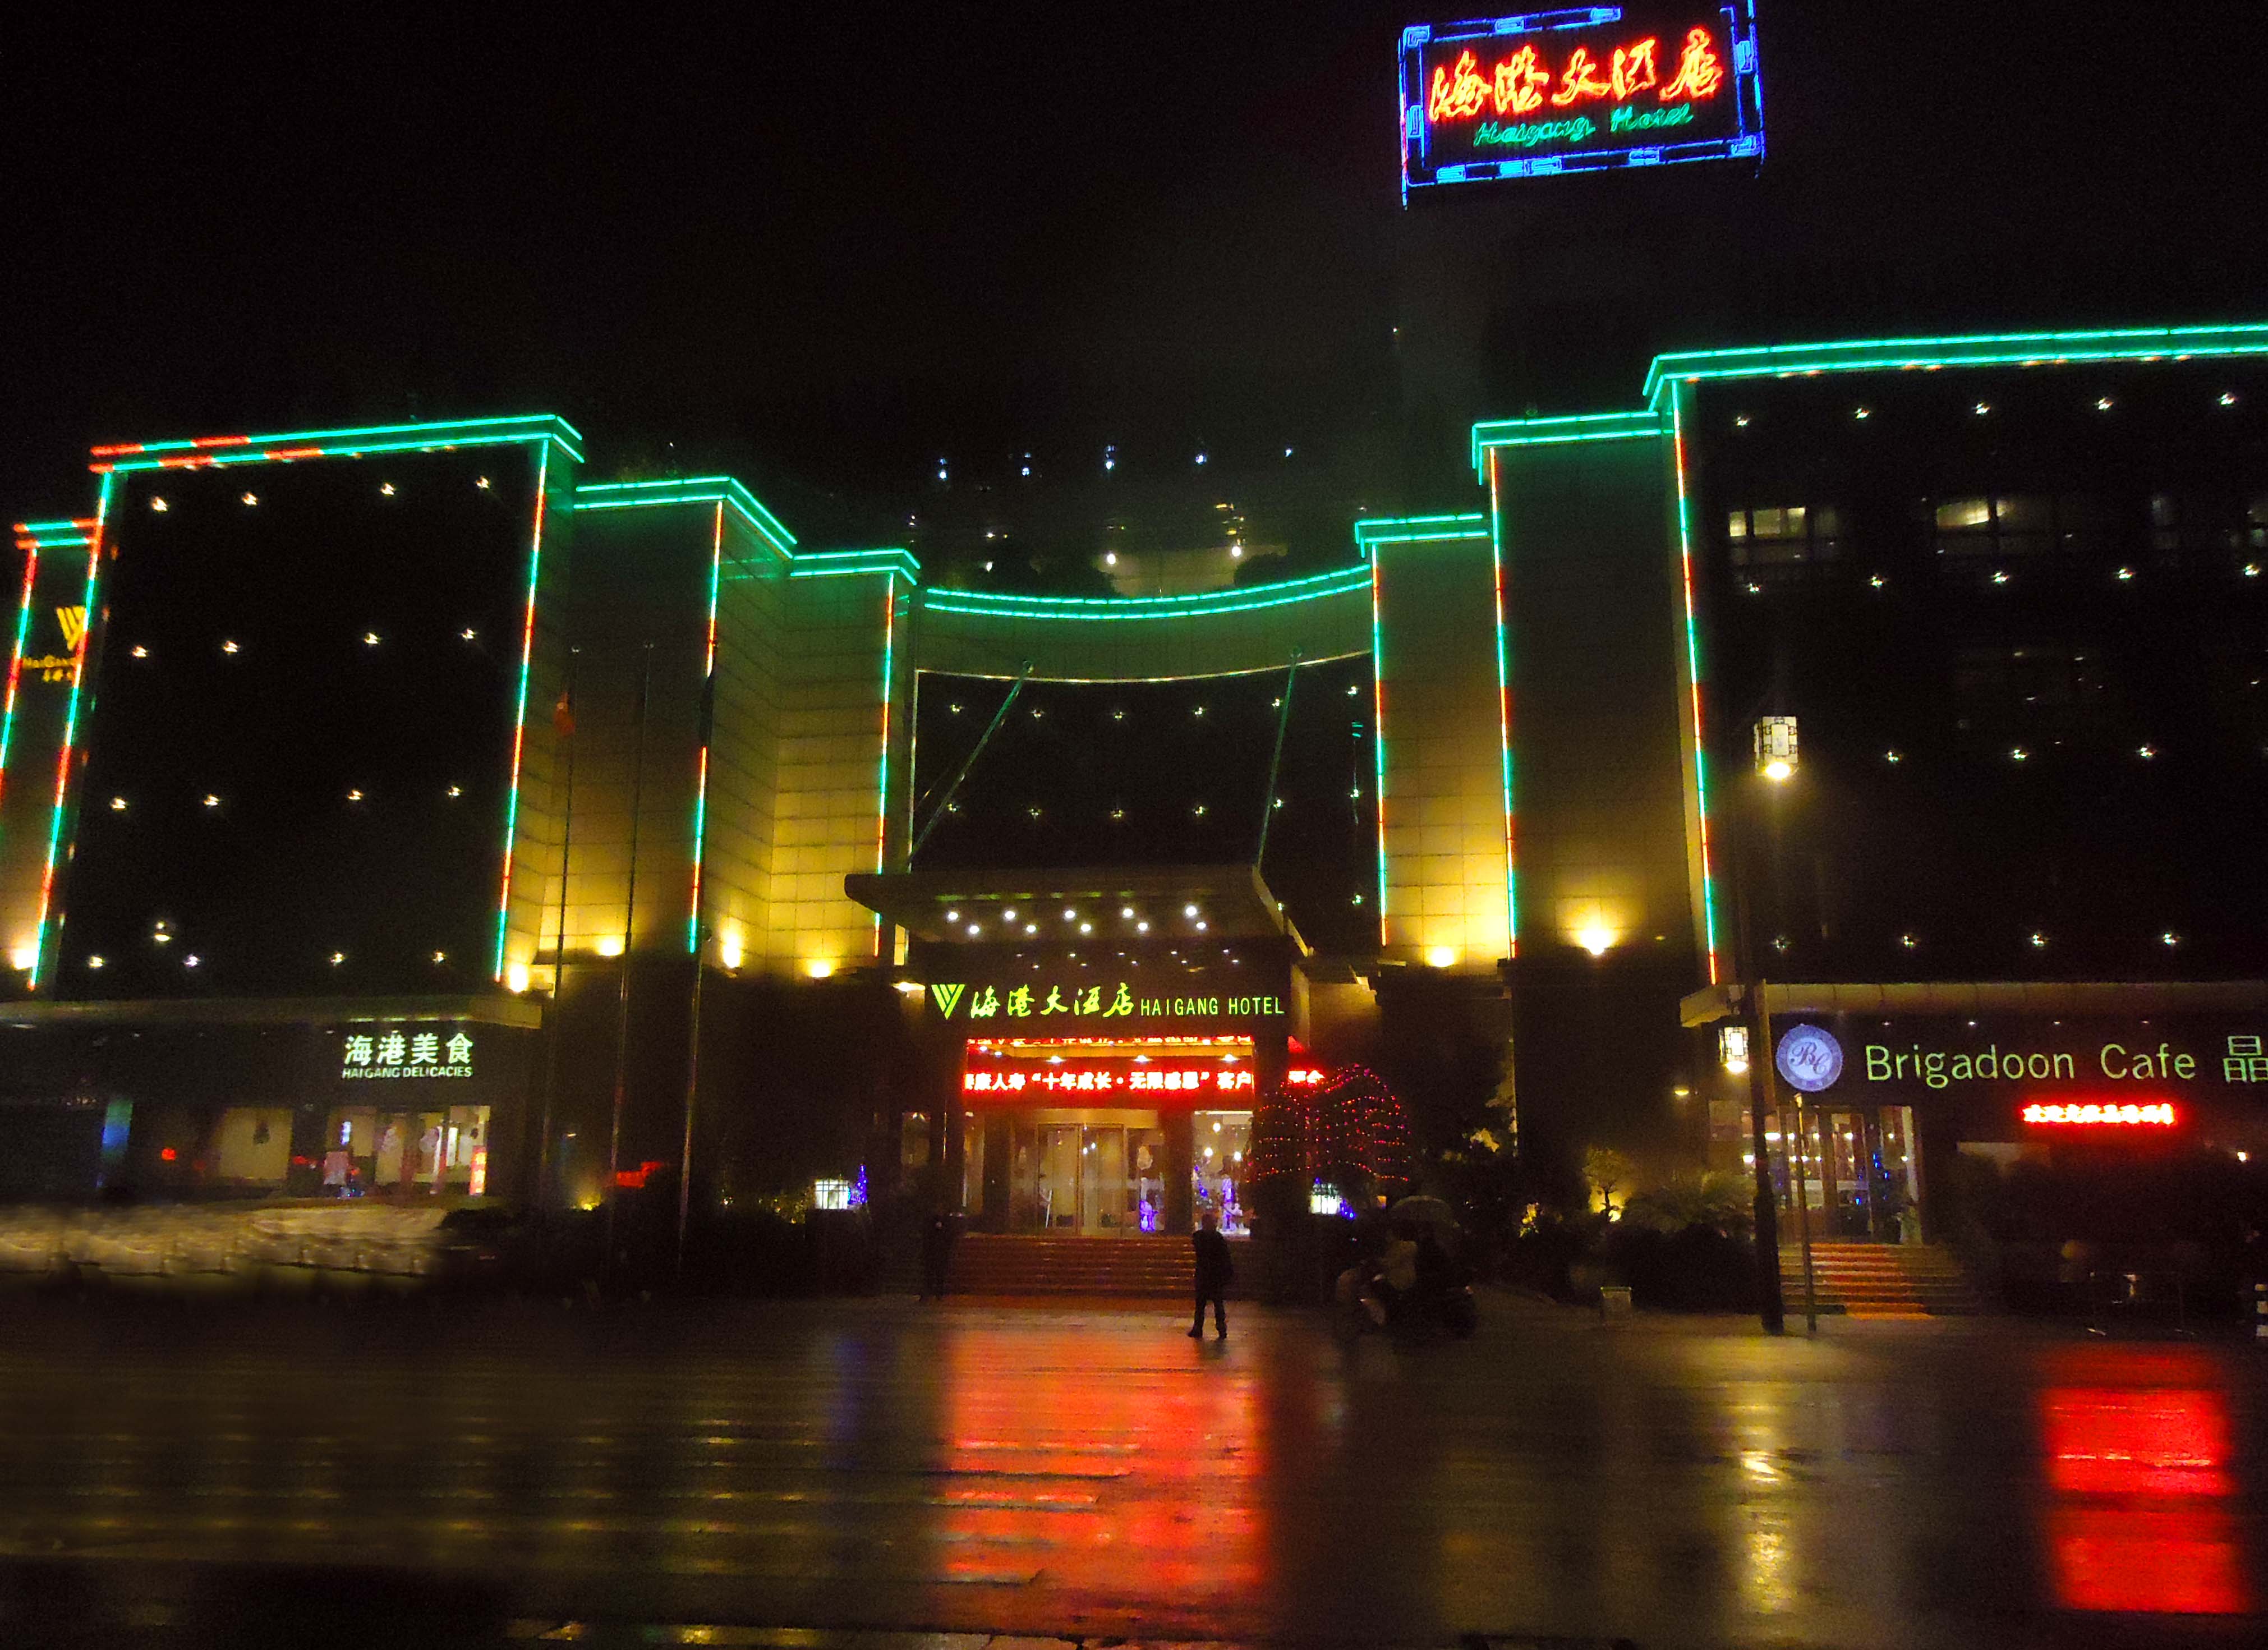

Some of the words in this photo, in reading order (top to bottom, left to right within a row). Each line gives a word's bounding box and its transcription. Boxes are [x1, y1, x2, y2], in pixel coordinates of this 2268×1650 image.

[1429, 27, 1723, 122] 海港大酒店
[1473, 116, 1597, 148] Haigang
[1610, 103, 1694, 134] Hotel
[970, 982, 1135, 1019] 海港大酒店
[1140, 997, 1219, 1016] HAIGANG
[1228, 996, 1285, 1015] HOTEL
[344, 1032, 473, 1066] 海港美食
[1865, 1044, 2075, 1089] Brigadoon
[2100, 1042, 2196, 1080] Cafe
[2223, 1035, 2268, 1083] 品
[342, 1067, 401, 1079] HAIGANG
[402, 1066, 474, 1078] DELICACIES
